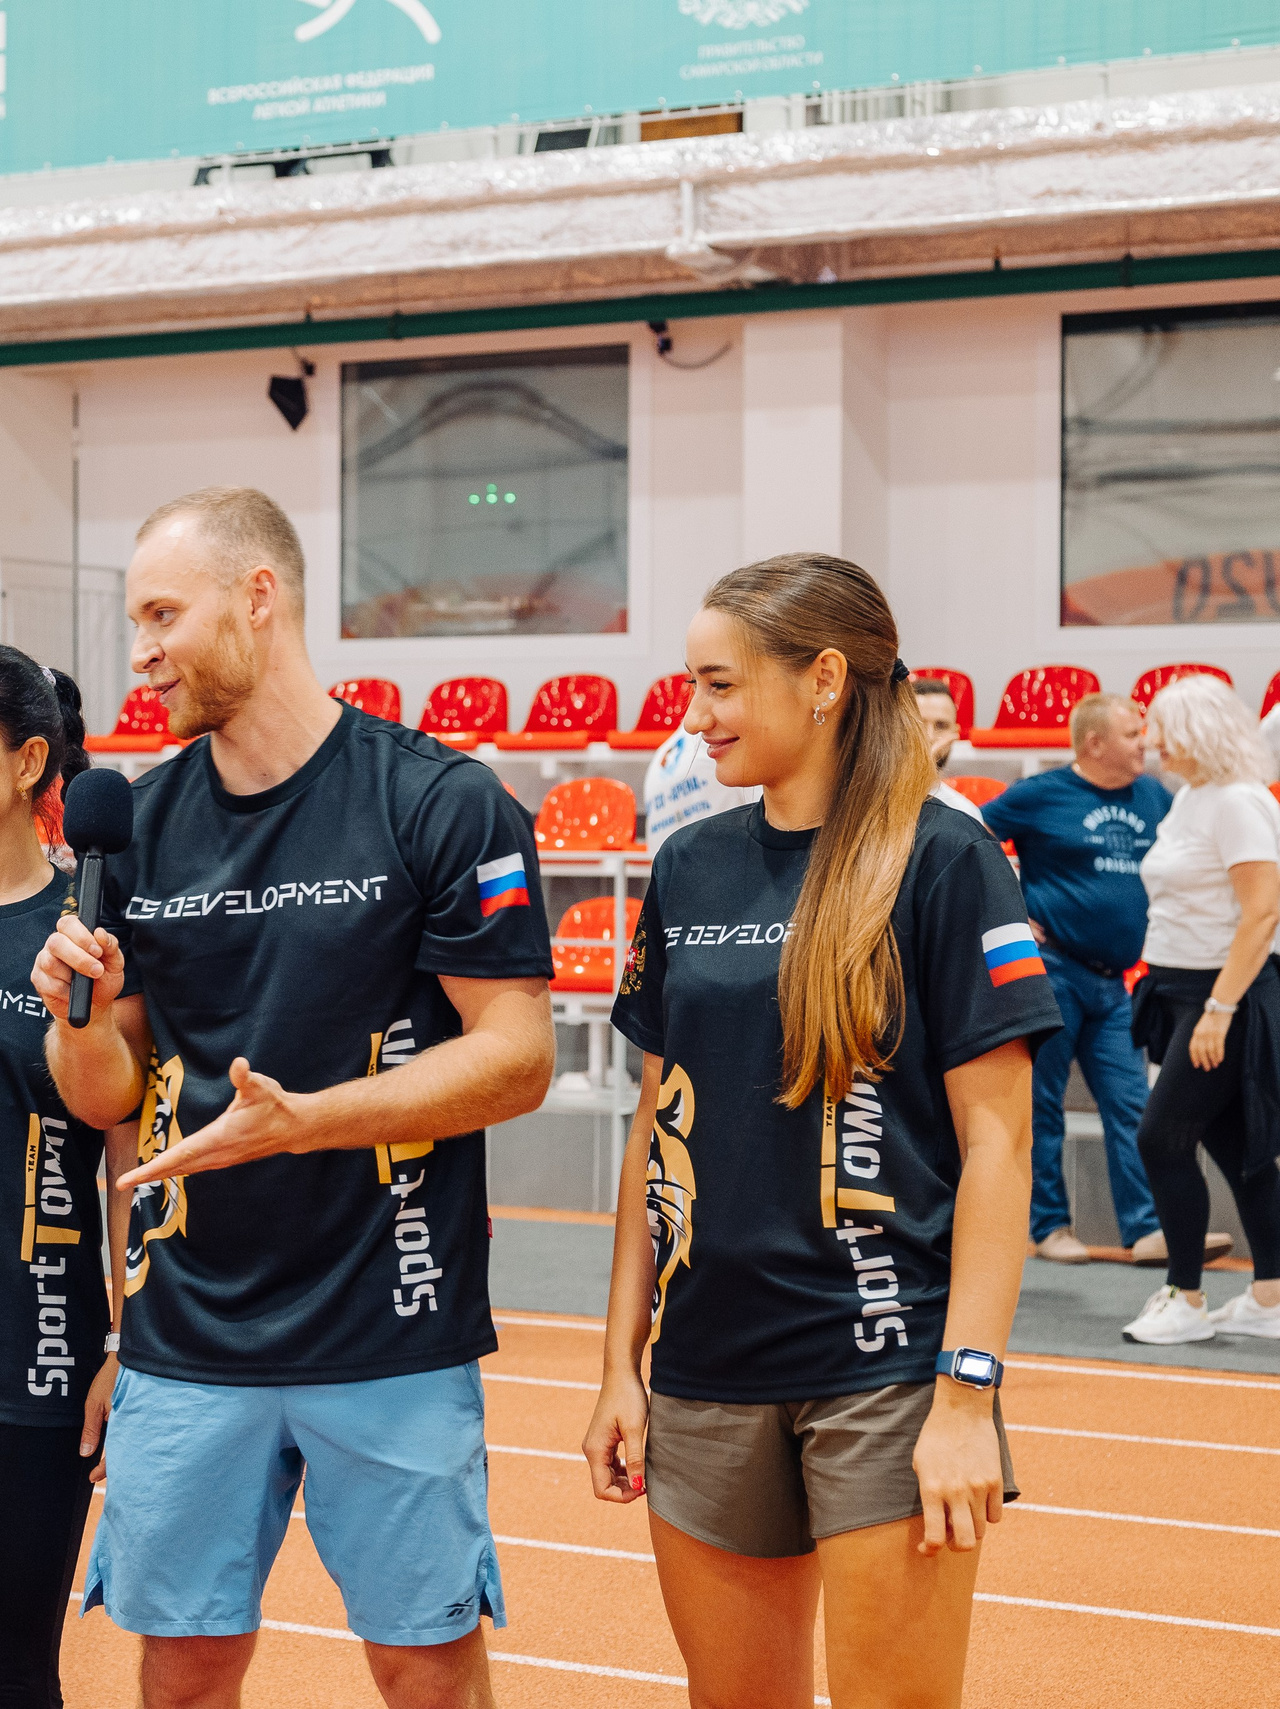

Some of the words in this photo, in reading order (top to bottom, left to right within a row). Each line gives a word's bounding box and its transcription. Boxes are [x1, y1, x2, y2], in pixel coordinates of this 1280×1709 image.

[1082, 805, 1147, 835] MUSTANG
[1094, 856, 1142, 876] ORIGIN
[125, 895, 160, 920] CS
[162, 875, 388, 919] DEVELOPMENT
[825, 1095, 834, 1128] TEAM
[27, 1144, 37, 1173] TEAM
[390, 1168, 443, 1318] Sport
[27, 1255, 76, 1397] Sport
